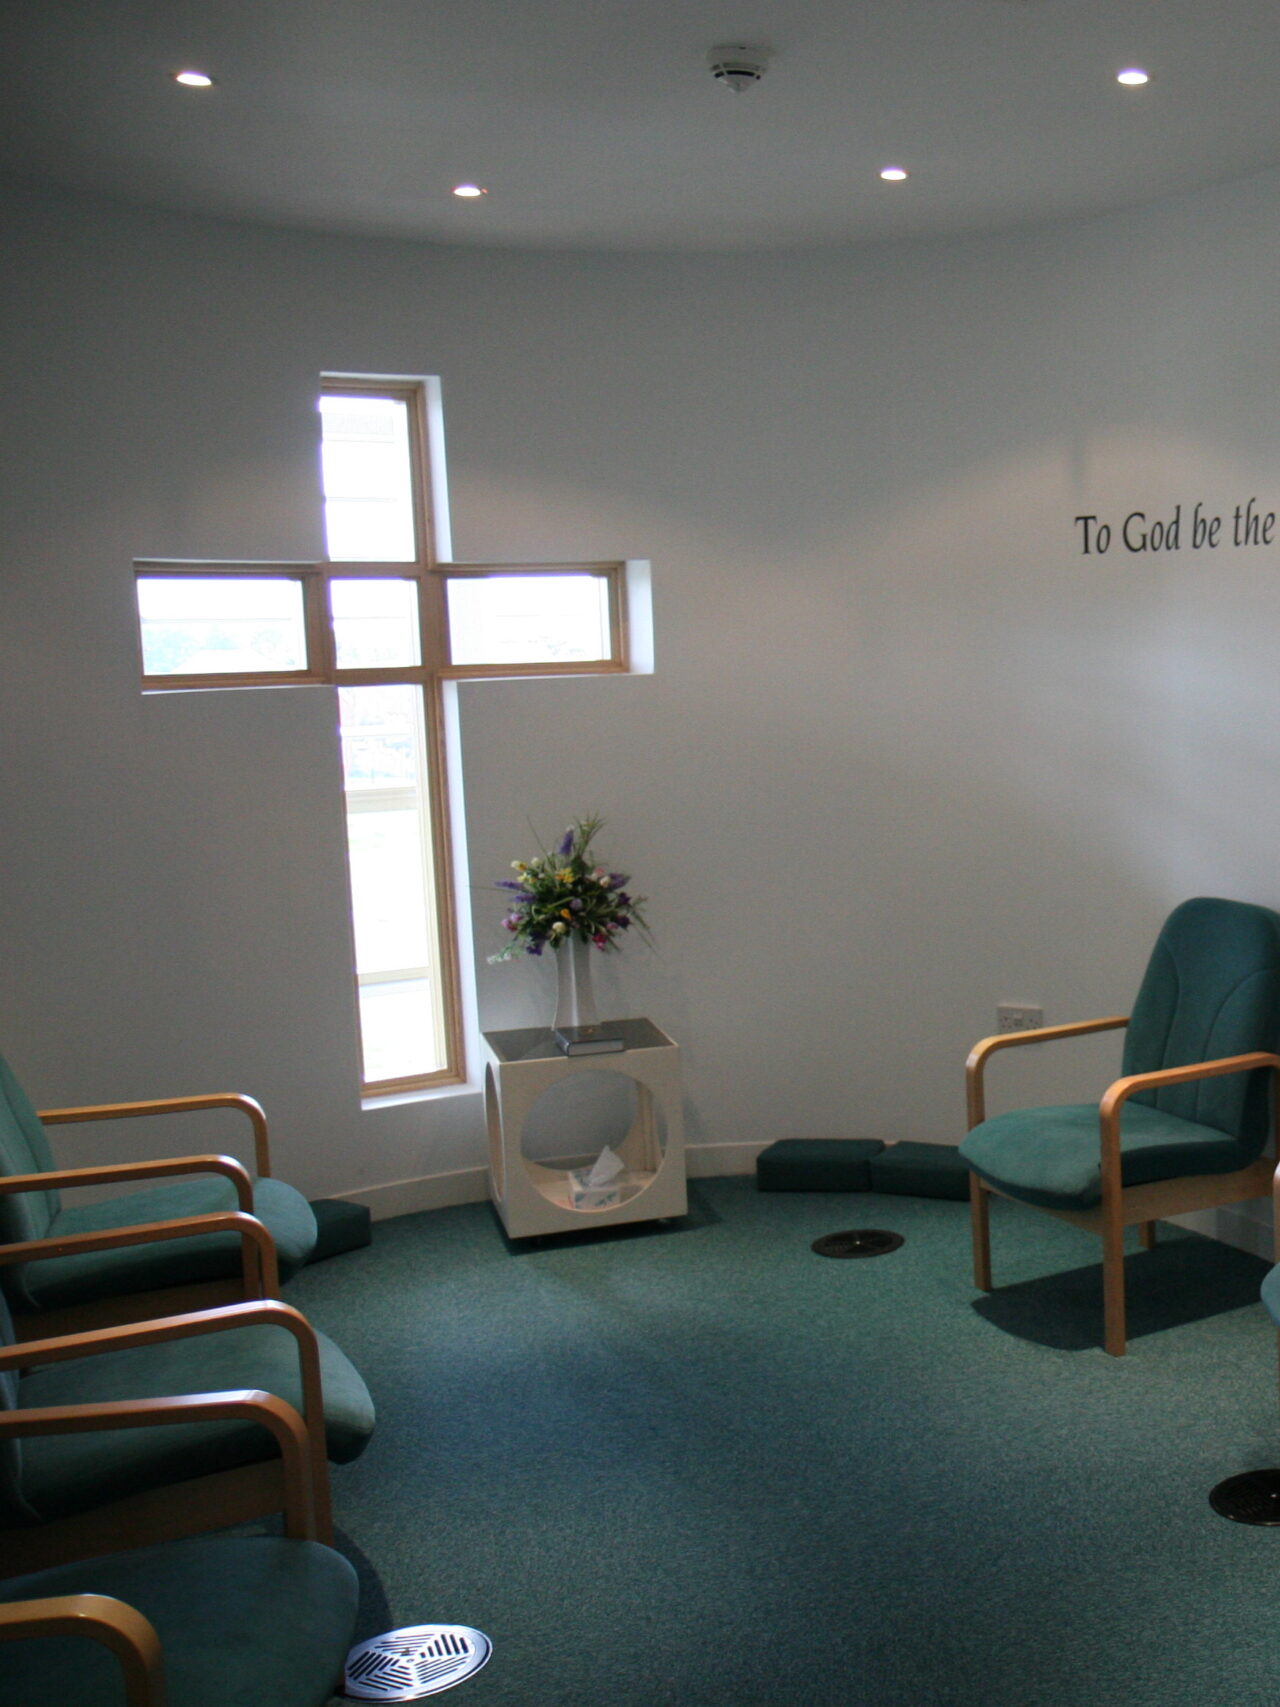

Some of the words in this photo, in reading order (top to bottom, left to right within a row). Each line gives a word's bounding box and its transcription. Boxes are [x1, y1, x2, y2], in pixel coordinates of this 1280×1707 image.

[1075, 514, 1111, 554] To
[1123, 505, 1181, 552] God
[1191, 503, 1221, 549] be
[1234, 498, 1275, 546] the
